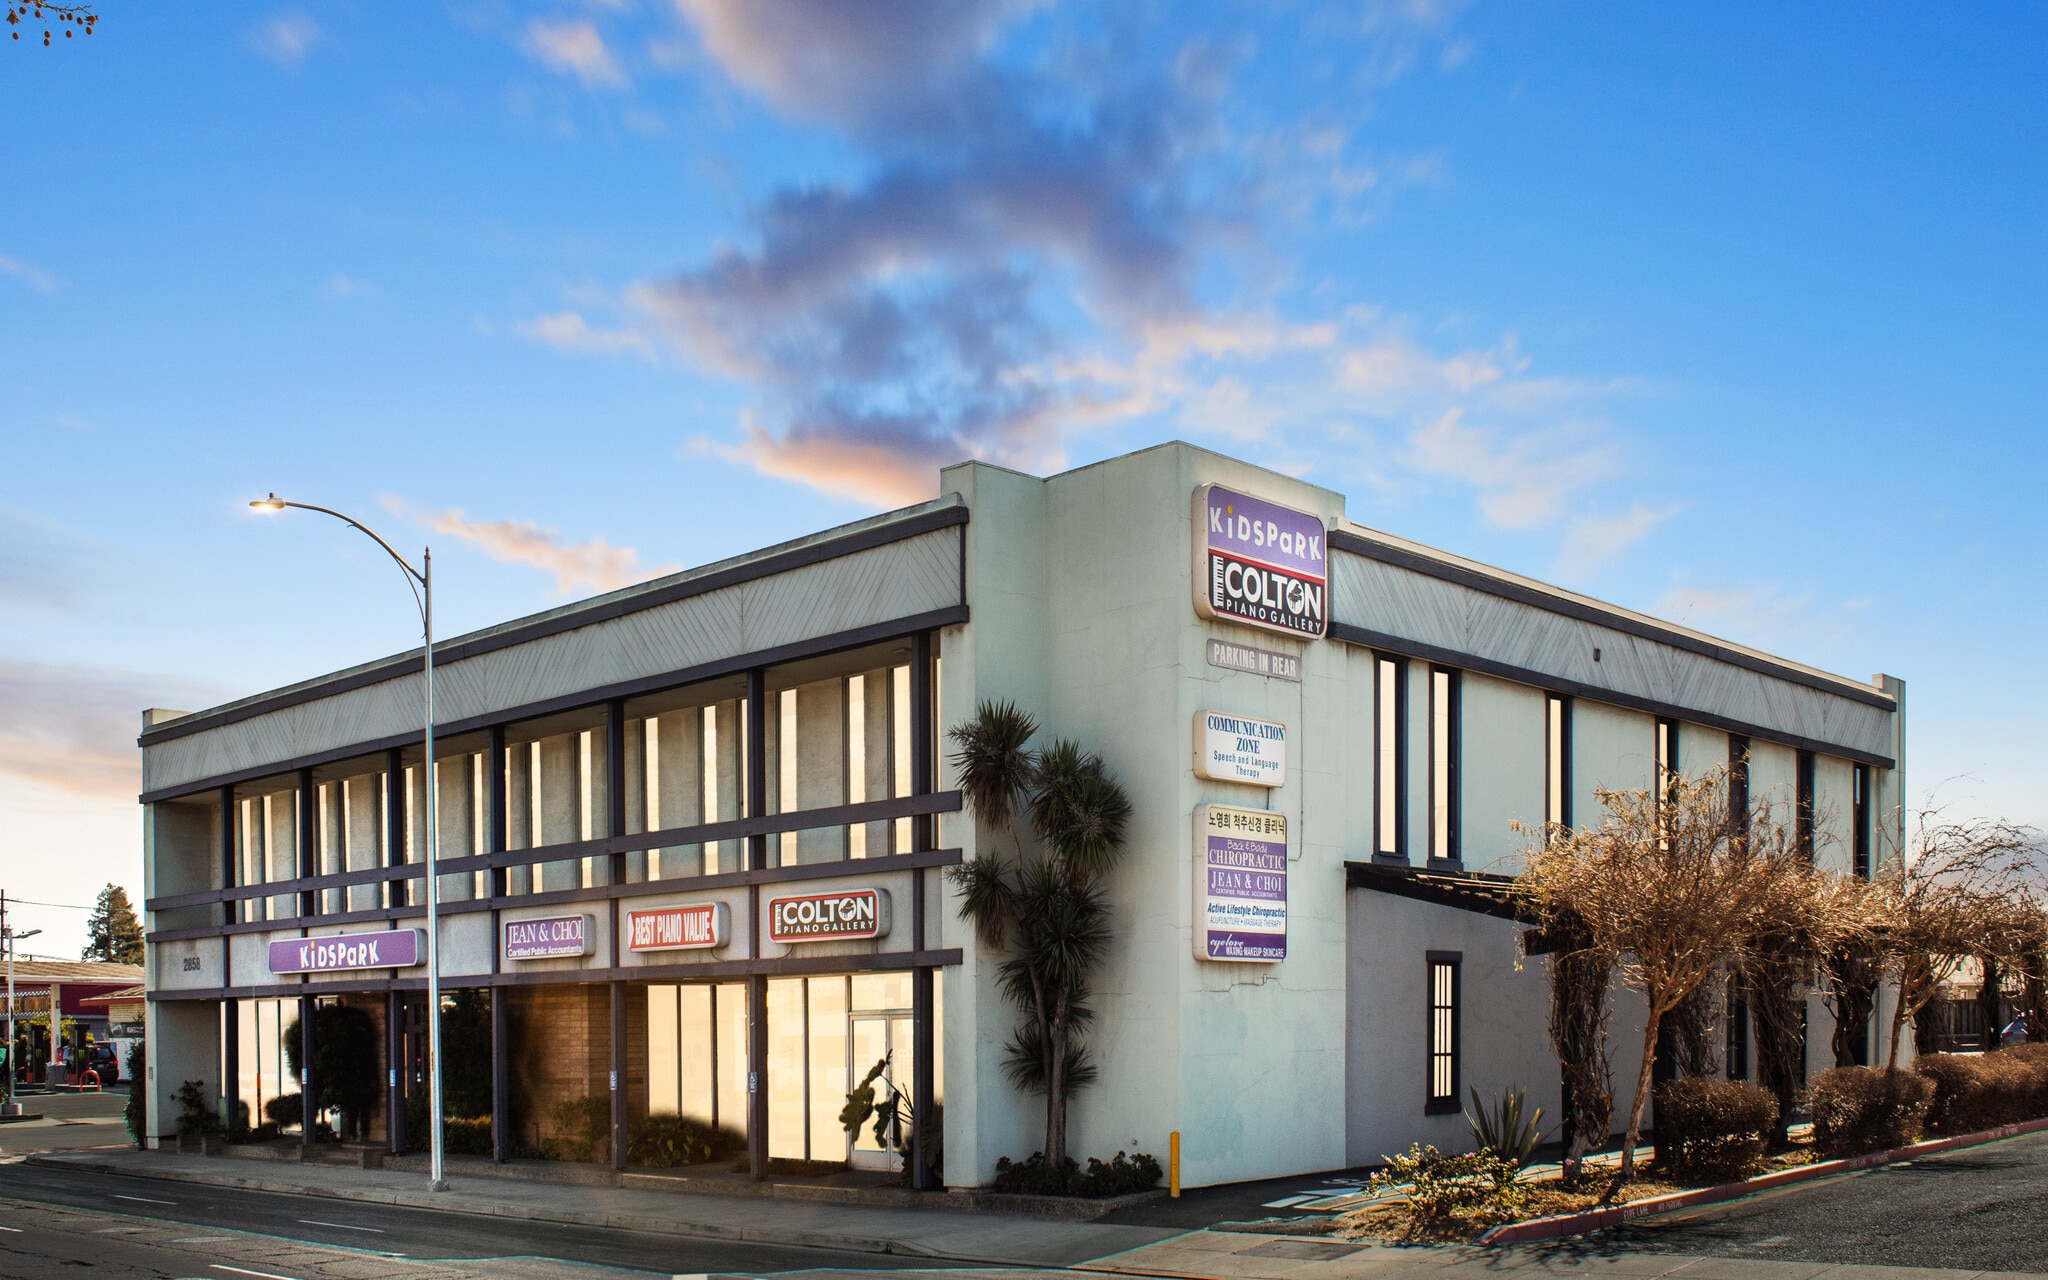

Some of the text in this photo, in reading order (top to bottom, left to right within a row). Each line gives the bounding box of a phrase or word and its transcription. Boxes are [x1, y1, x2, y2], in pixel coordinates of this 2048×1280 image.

[1224, 561, 1321, 620] COLTON
[1226, 599, 1321, 634] PIANO GALLERY
[1213, 643, 1297, 678] PARKING IN REAR
[1207, 715, 1285, 742] COMMUNICATION
[1236, 737, 1260, 755] ZONE
[1213, 750, 1279, 771] Speech and Language
[1236, 764, 1260, 779] Therapy
[1264, 818, 1285, 836] 클리닉
[1227, 839, 1244, 851] Back
[1250, 842, 1268, 854] Body
[1209, 848, 1285, 870] CHIROPRACTIC
[1211, 871, 1282, 891] JEAN & CHOI
[1215, 888, 1235, 896] CERTIFIED
[1236, 889, 1250, 897] PUBLIC
[782, 896, 874, 925] COLTON
[1207, 902, 1286, 918] Active Lifestyle Chiropractic
[508, 920, 583, 948] JEAN & CHOI
[635, 911, 711, 946] BEST PIANO VALUE
[783, 920, 874, 934] PIANO GALLERY
[508, 944, 583, 957] Certified Public Accountants
[183, 957, 201, 971] 2858
